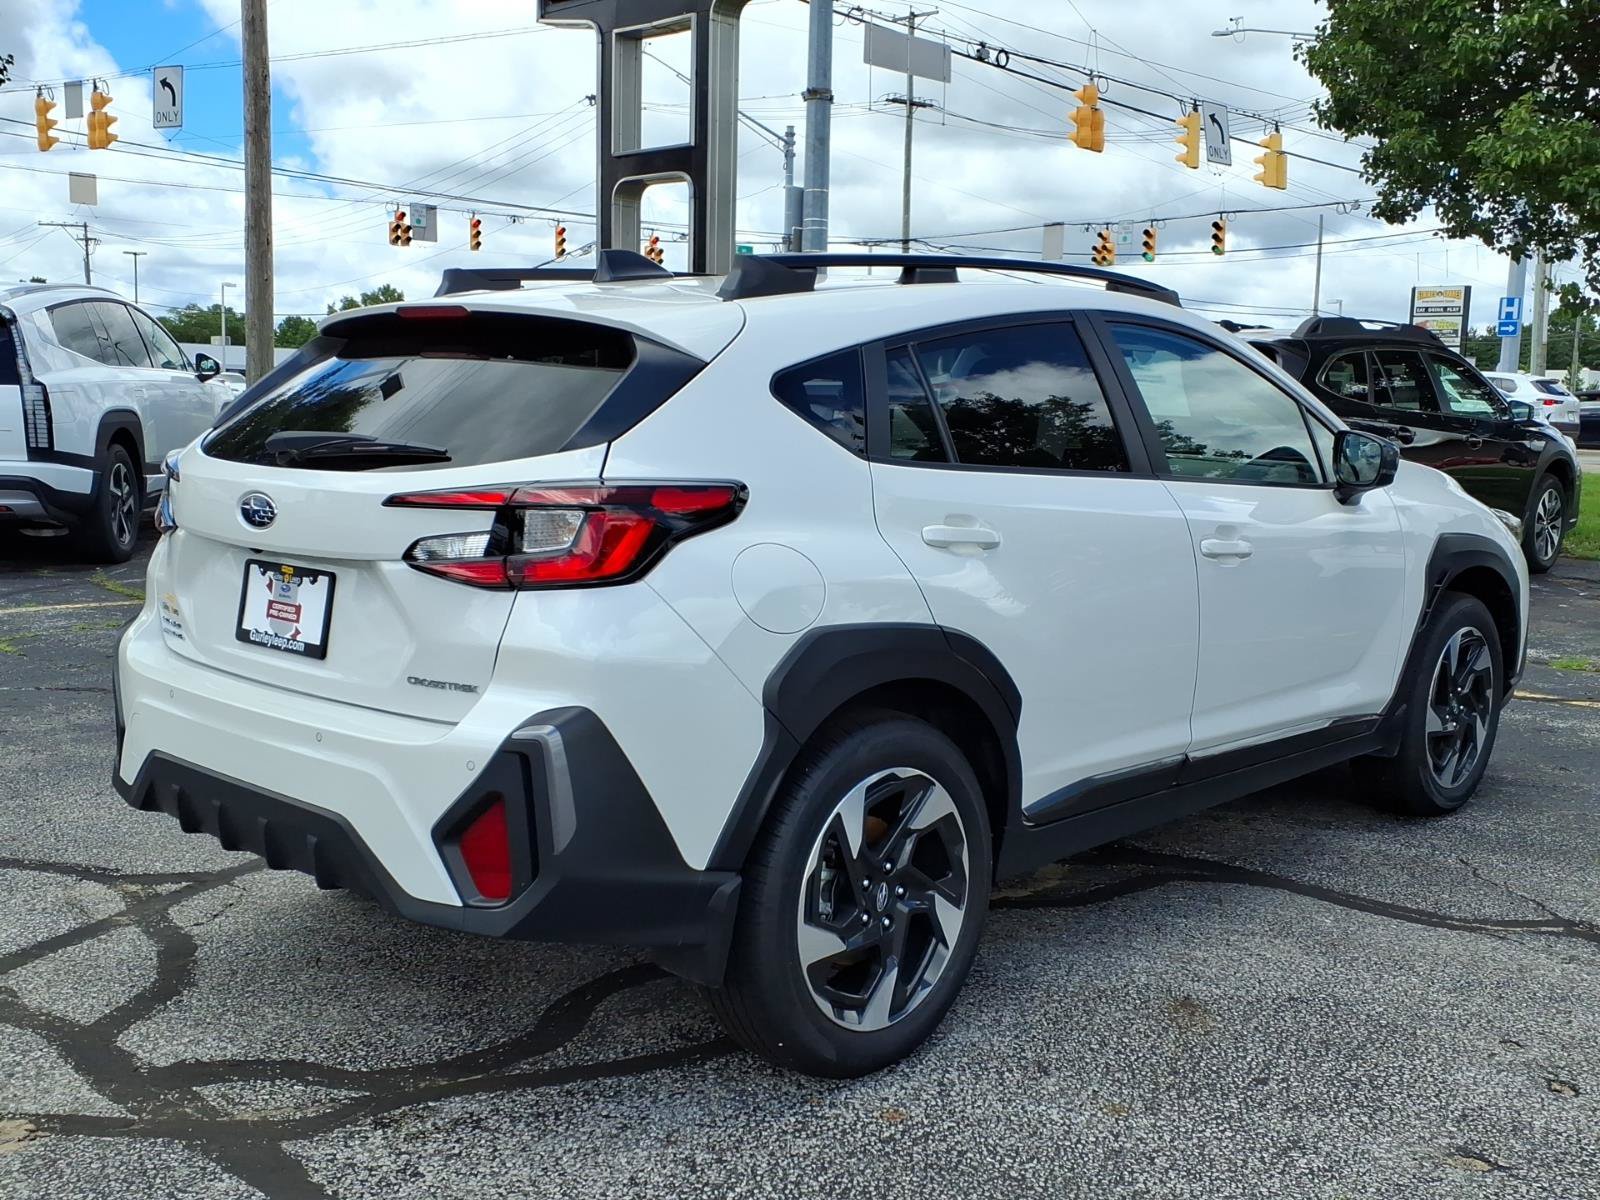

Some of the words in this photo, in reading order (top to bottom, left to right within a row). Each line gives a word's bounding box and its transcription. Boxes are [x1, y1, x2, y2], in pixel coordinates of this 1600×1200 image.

[156, 111, 180, 123] ONLY
[1209, 145, 1229, 159] ONLY
[1500, 298, 1520, 320] H
[272, 602, 296, 613] CERTIFIED
[407, 676, 479, 693] CROSSTREK
